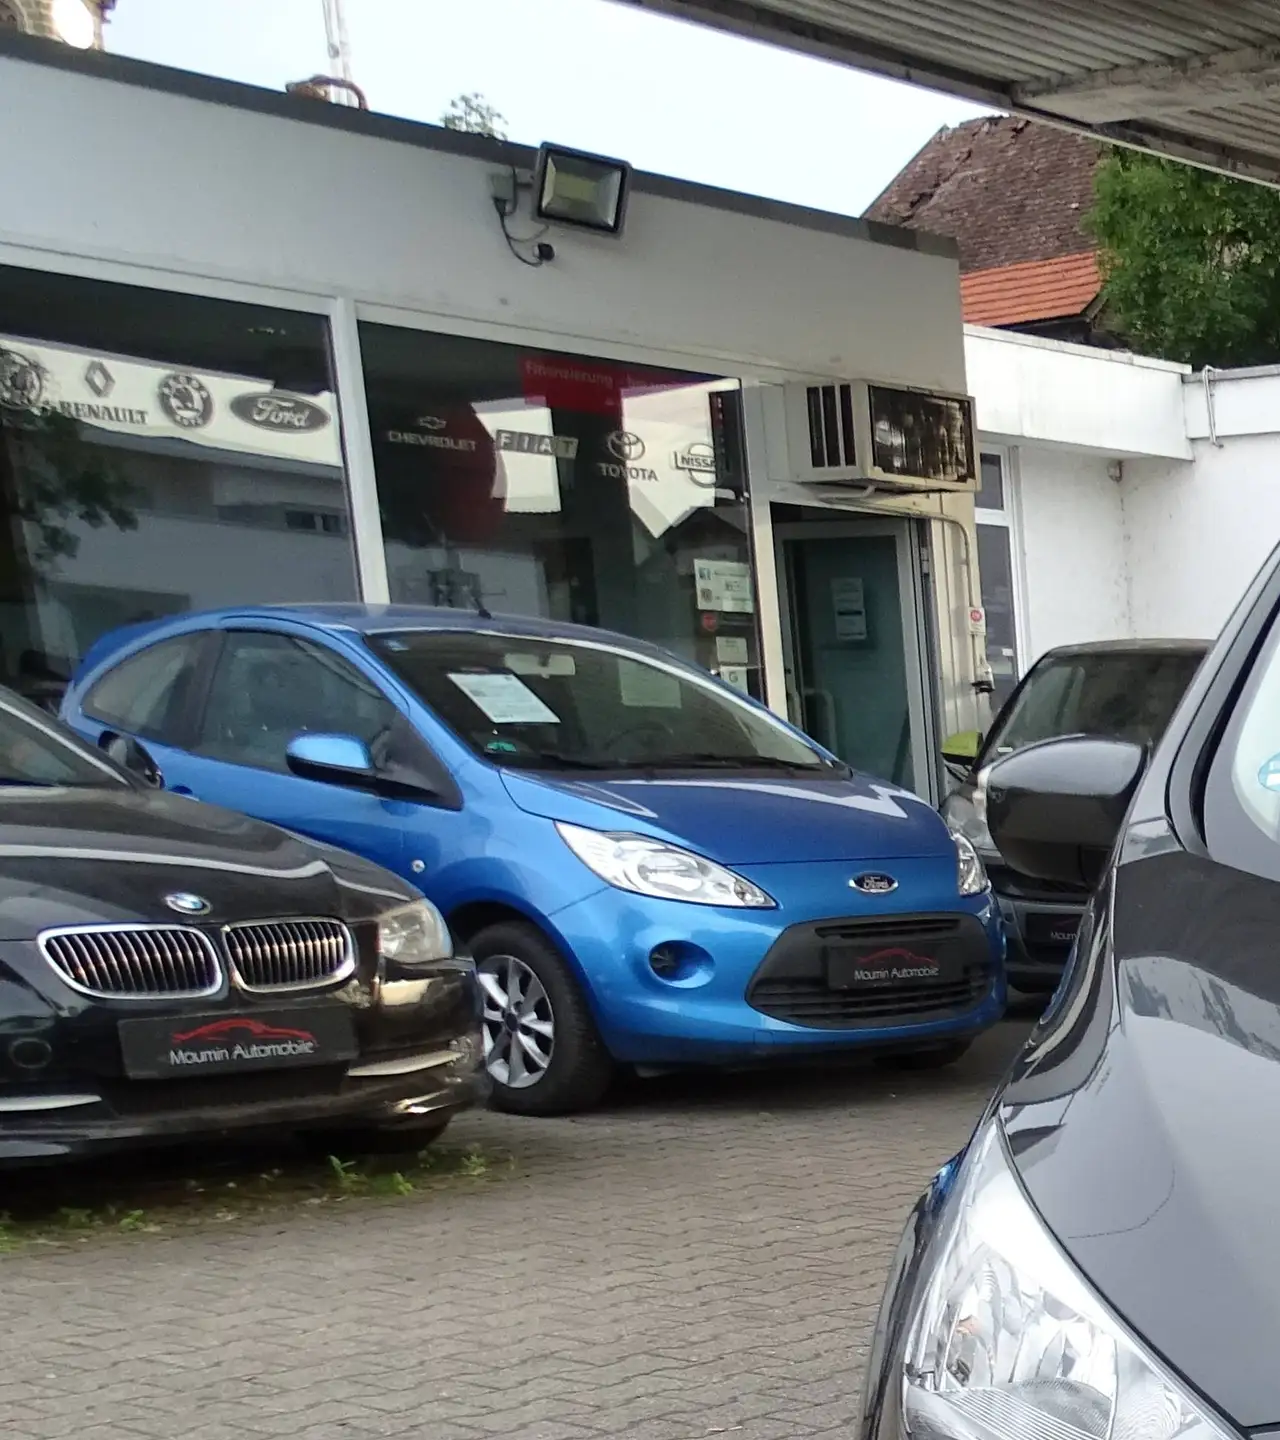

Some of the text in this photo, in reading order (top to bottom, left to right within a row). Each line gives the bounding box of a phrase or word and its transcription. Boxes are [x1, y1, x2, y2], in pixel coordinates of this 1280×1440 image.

[59, 401, 148, 425] RENAULT
[251, 398, 310, 428] Ford
[388, 430, 477, 452] CHEVROLET
[500, 432, 575, 454] FIAT
[600, 462, 659, 482] TOYOTA
[681, 454, 718, 469] NISSA
[854, 965, 939, 981] Moumin Automobile
[169, 1038, 314, 1066] Moumin Automobile
